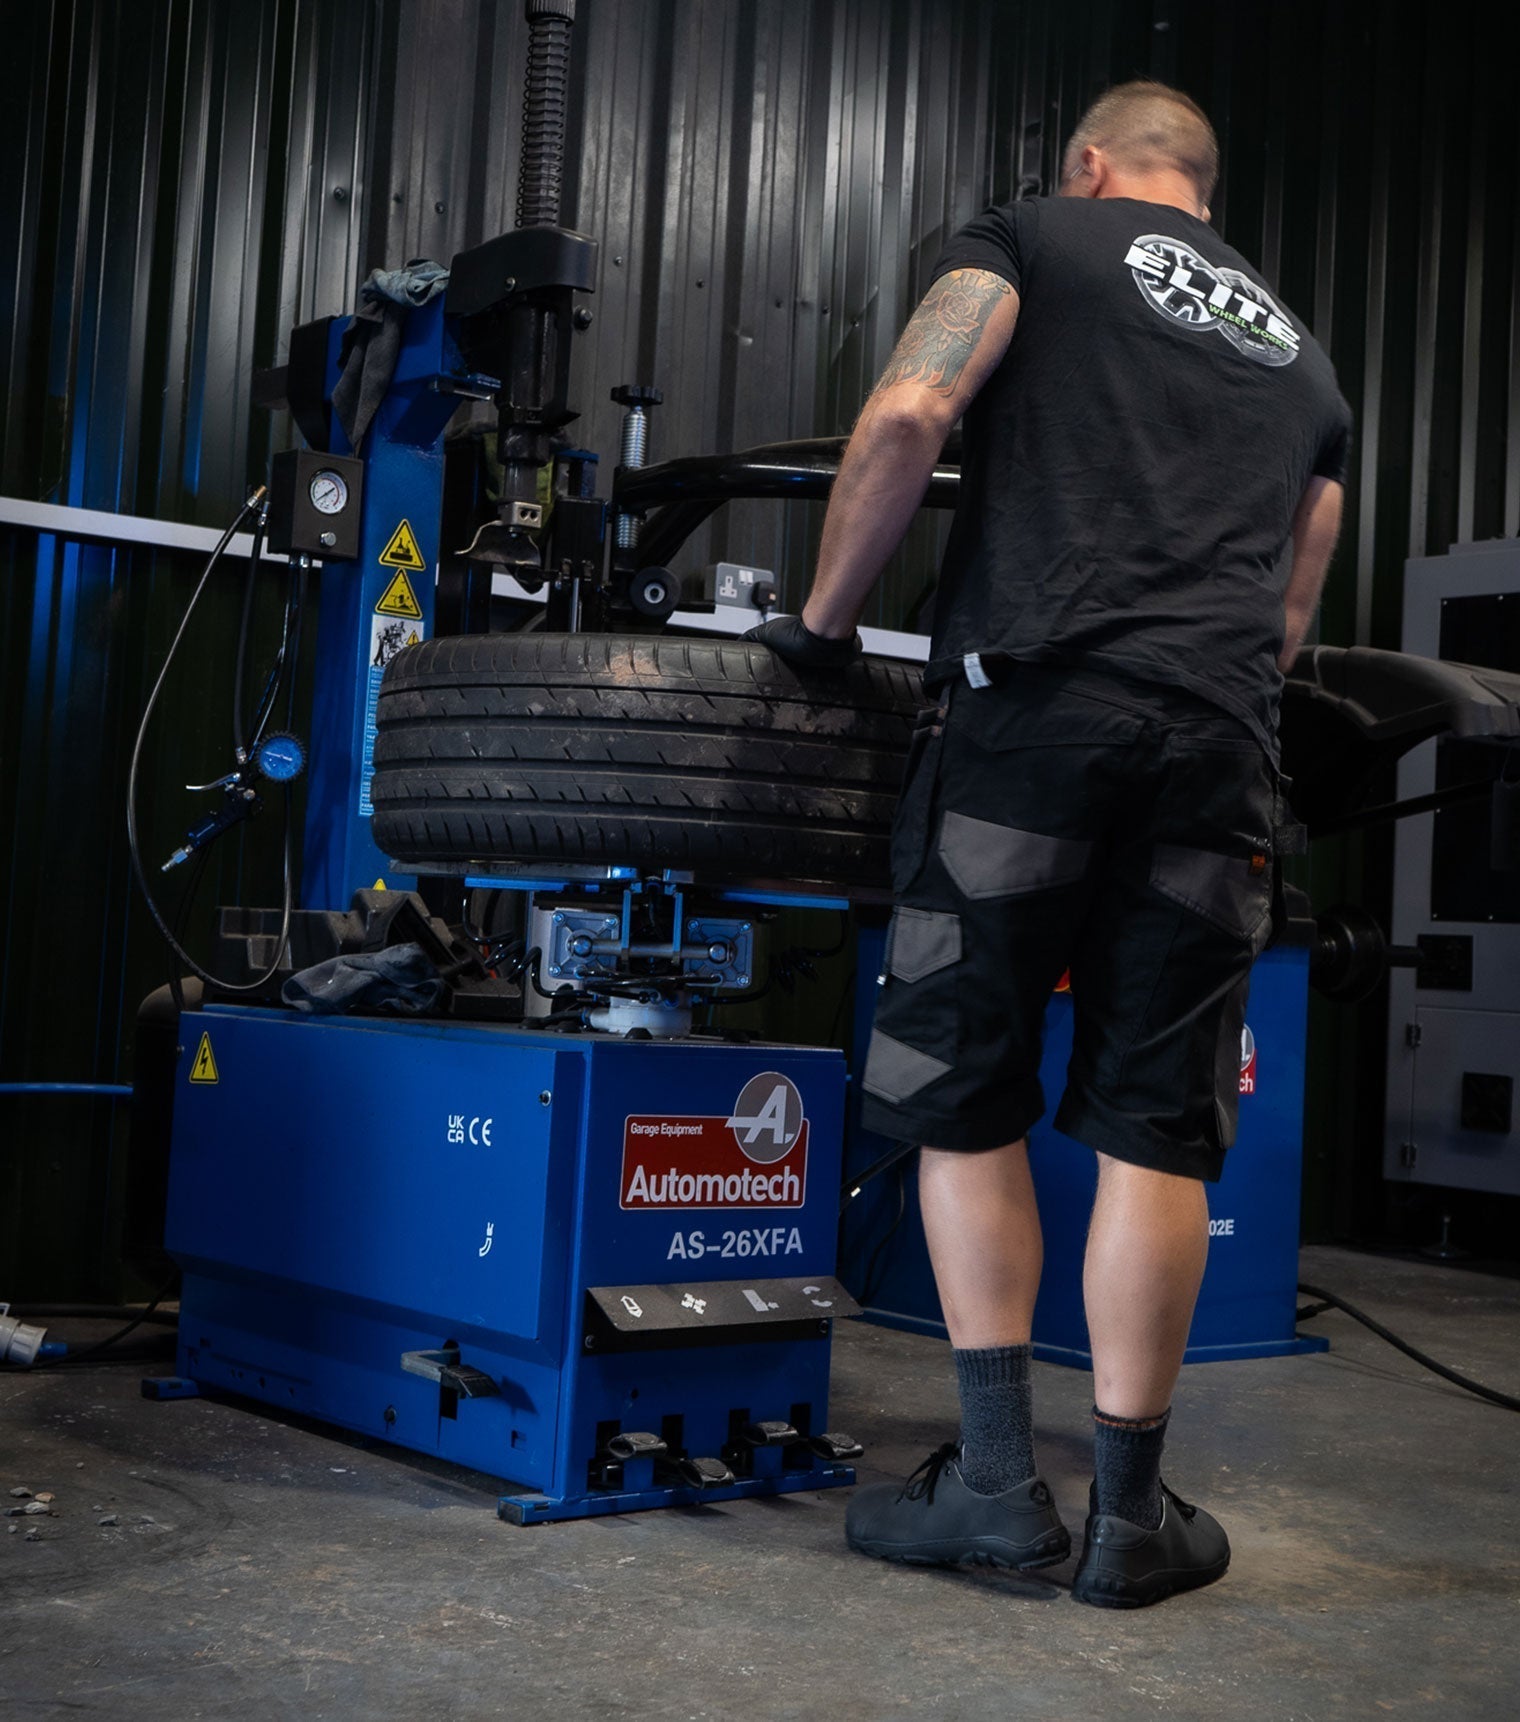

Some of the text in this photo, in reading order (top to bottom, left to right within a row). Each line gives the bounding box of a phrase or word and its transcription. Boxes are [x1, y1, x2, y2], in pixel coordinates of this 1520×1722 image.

[1124, 244, 1300, 351] ELITE
[1208, 304, 1289, 350] WHEEL WORKS
[447, 1129, 465, 1144] CA
[448, 1115, 465, 1129] UK
[469, 1117, 493, 1147] CE
[630, 1122, 703, 1137] Garage Equipment
[626, 1165, 800, 1203] Automotech
[666, 1227, 804, 1260] AS-26XFA
